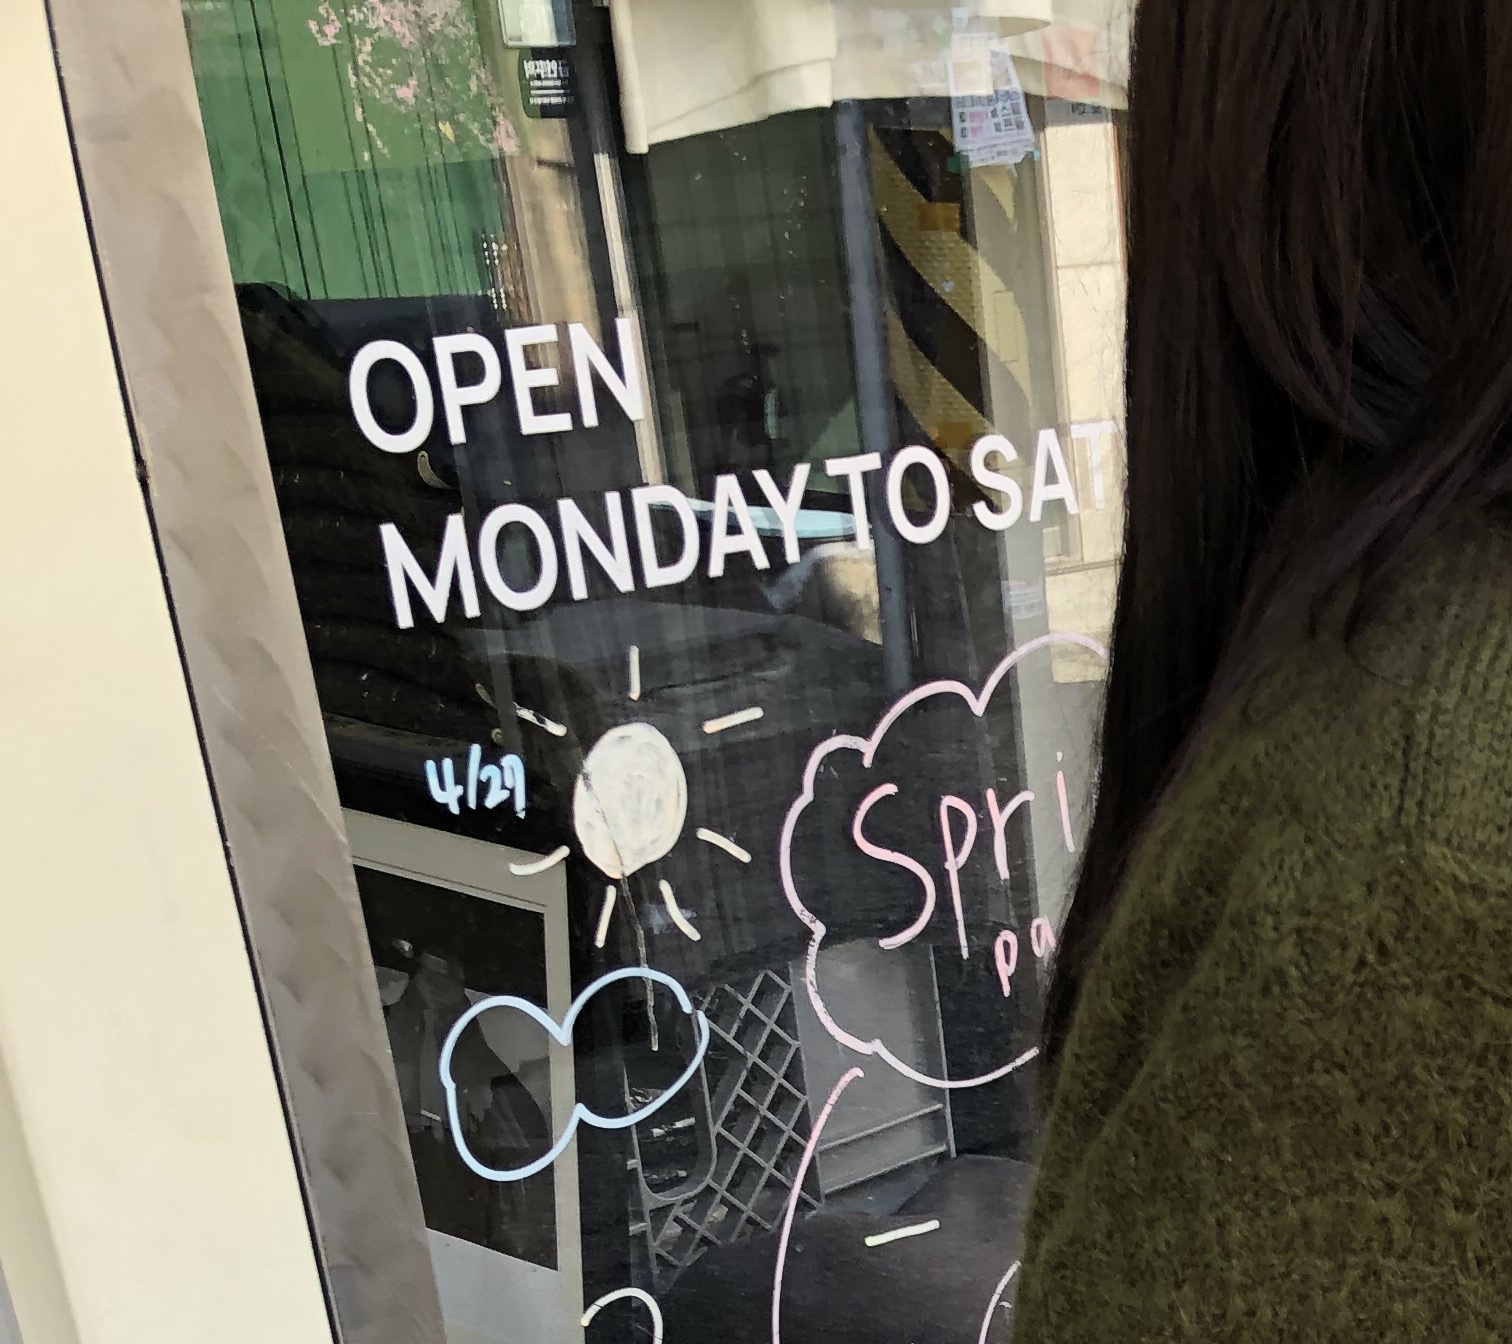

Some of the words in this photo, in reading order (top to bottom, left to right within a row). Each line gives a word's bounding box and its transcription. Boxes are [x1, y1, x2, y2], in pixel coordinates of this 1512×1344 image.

[349, 317, 645, 454] OPEN
[380, 463, 809, 630] MONDAY
[825, 445, 949, 552] TO
[969, 419, 1119, 532] SAT
